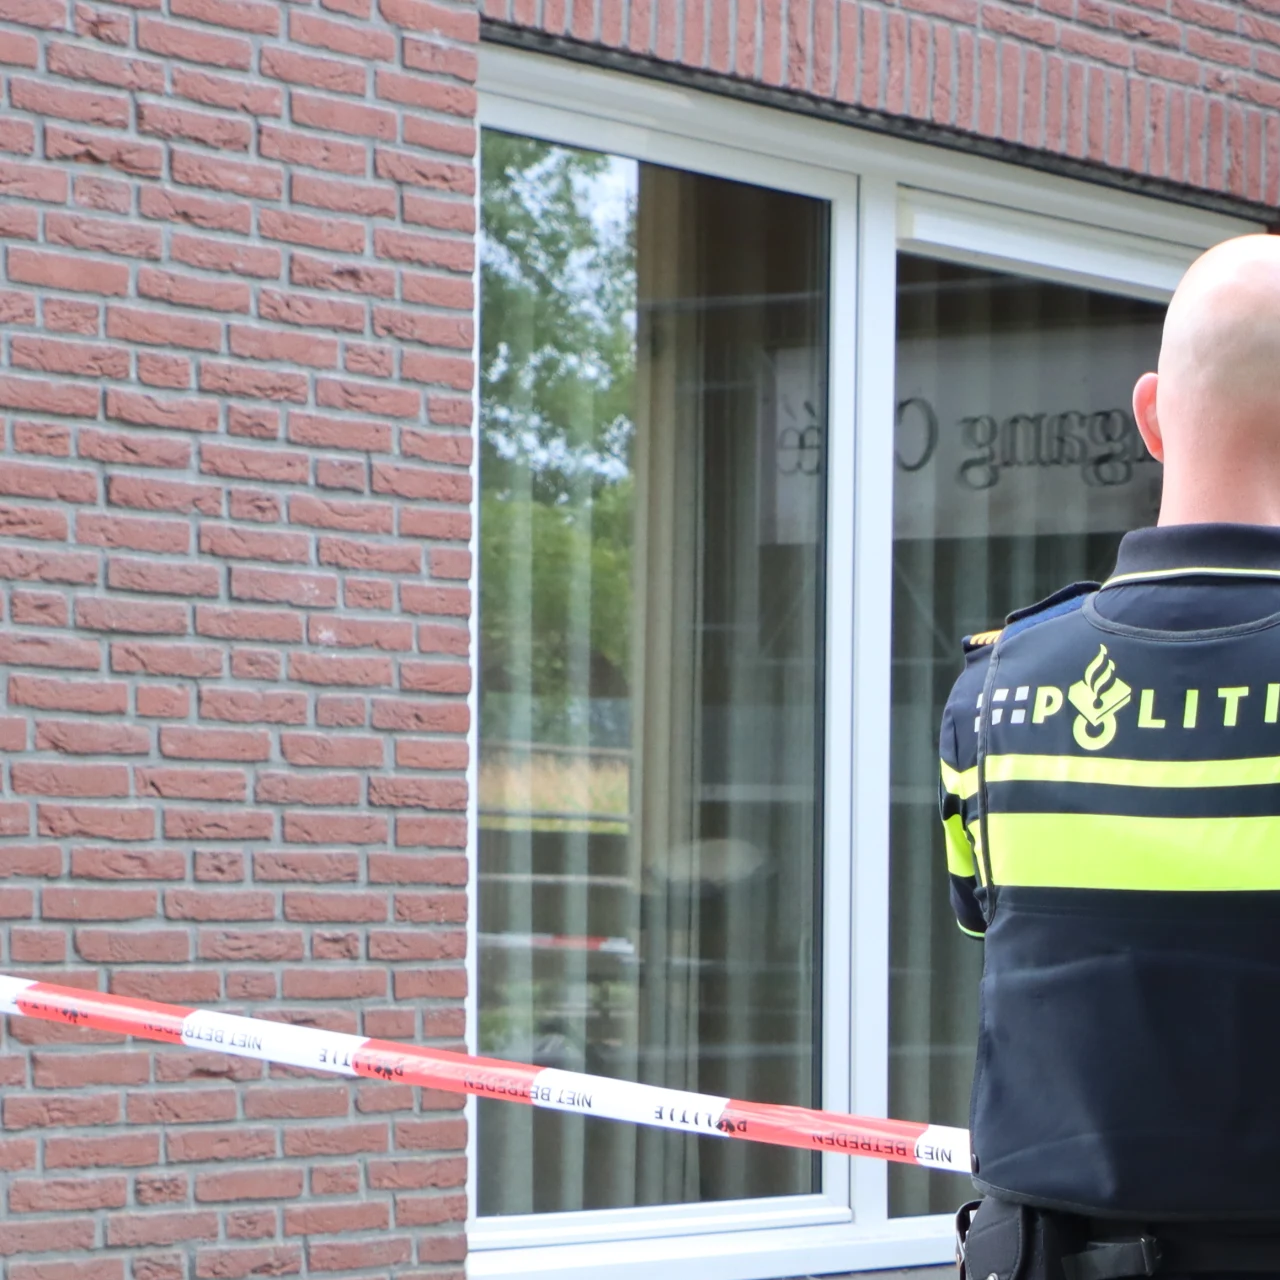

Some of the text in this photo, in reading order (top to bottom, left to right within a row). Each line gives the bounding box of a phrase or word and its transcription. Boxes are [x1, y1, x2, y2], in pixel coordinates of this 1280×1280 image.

[556, 1087, 593, 1108] NIET
[811, 1131, 953, 1163] NIET BETREDEN
